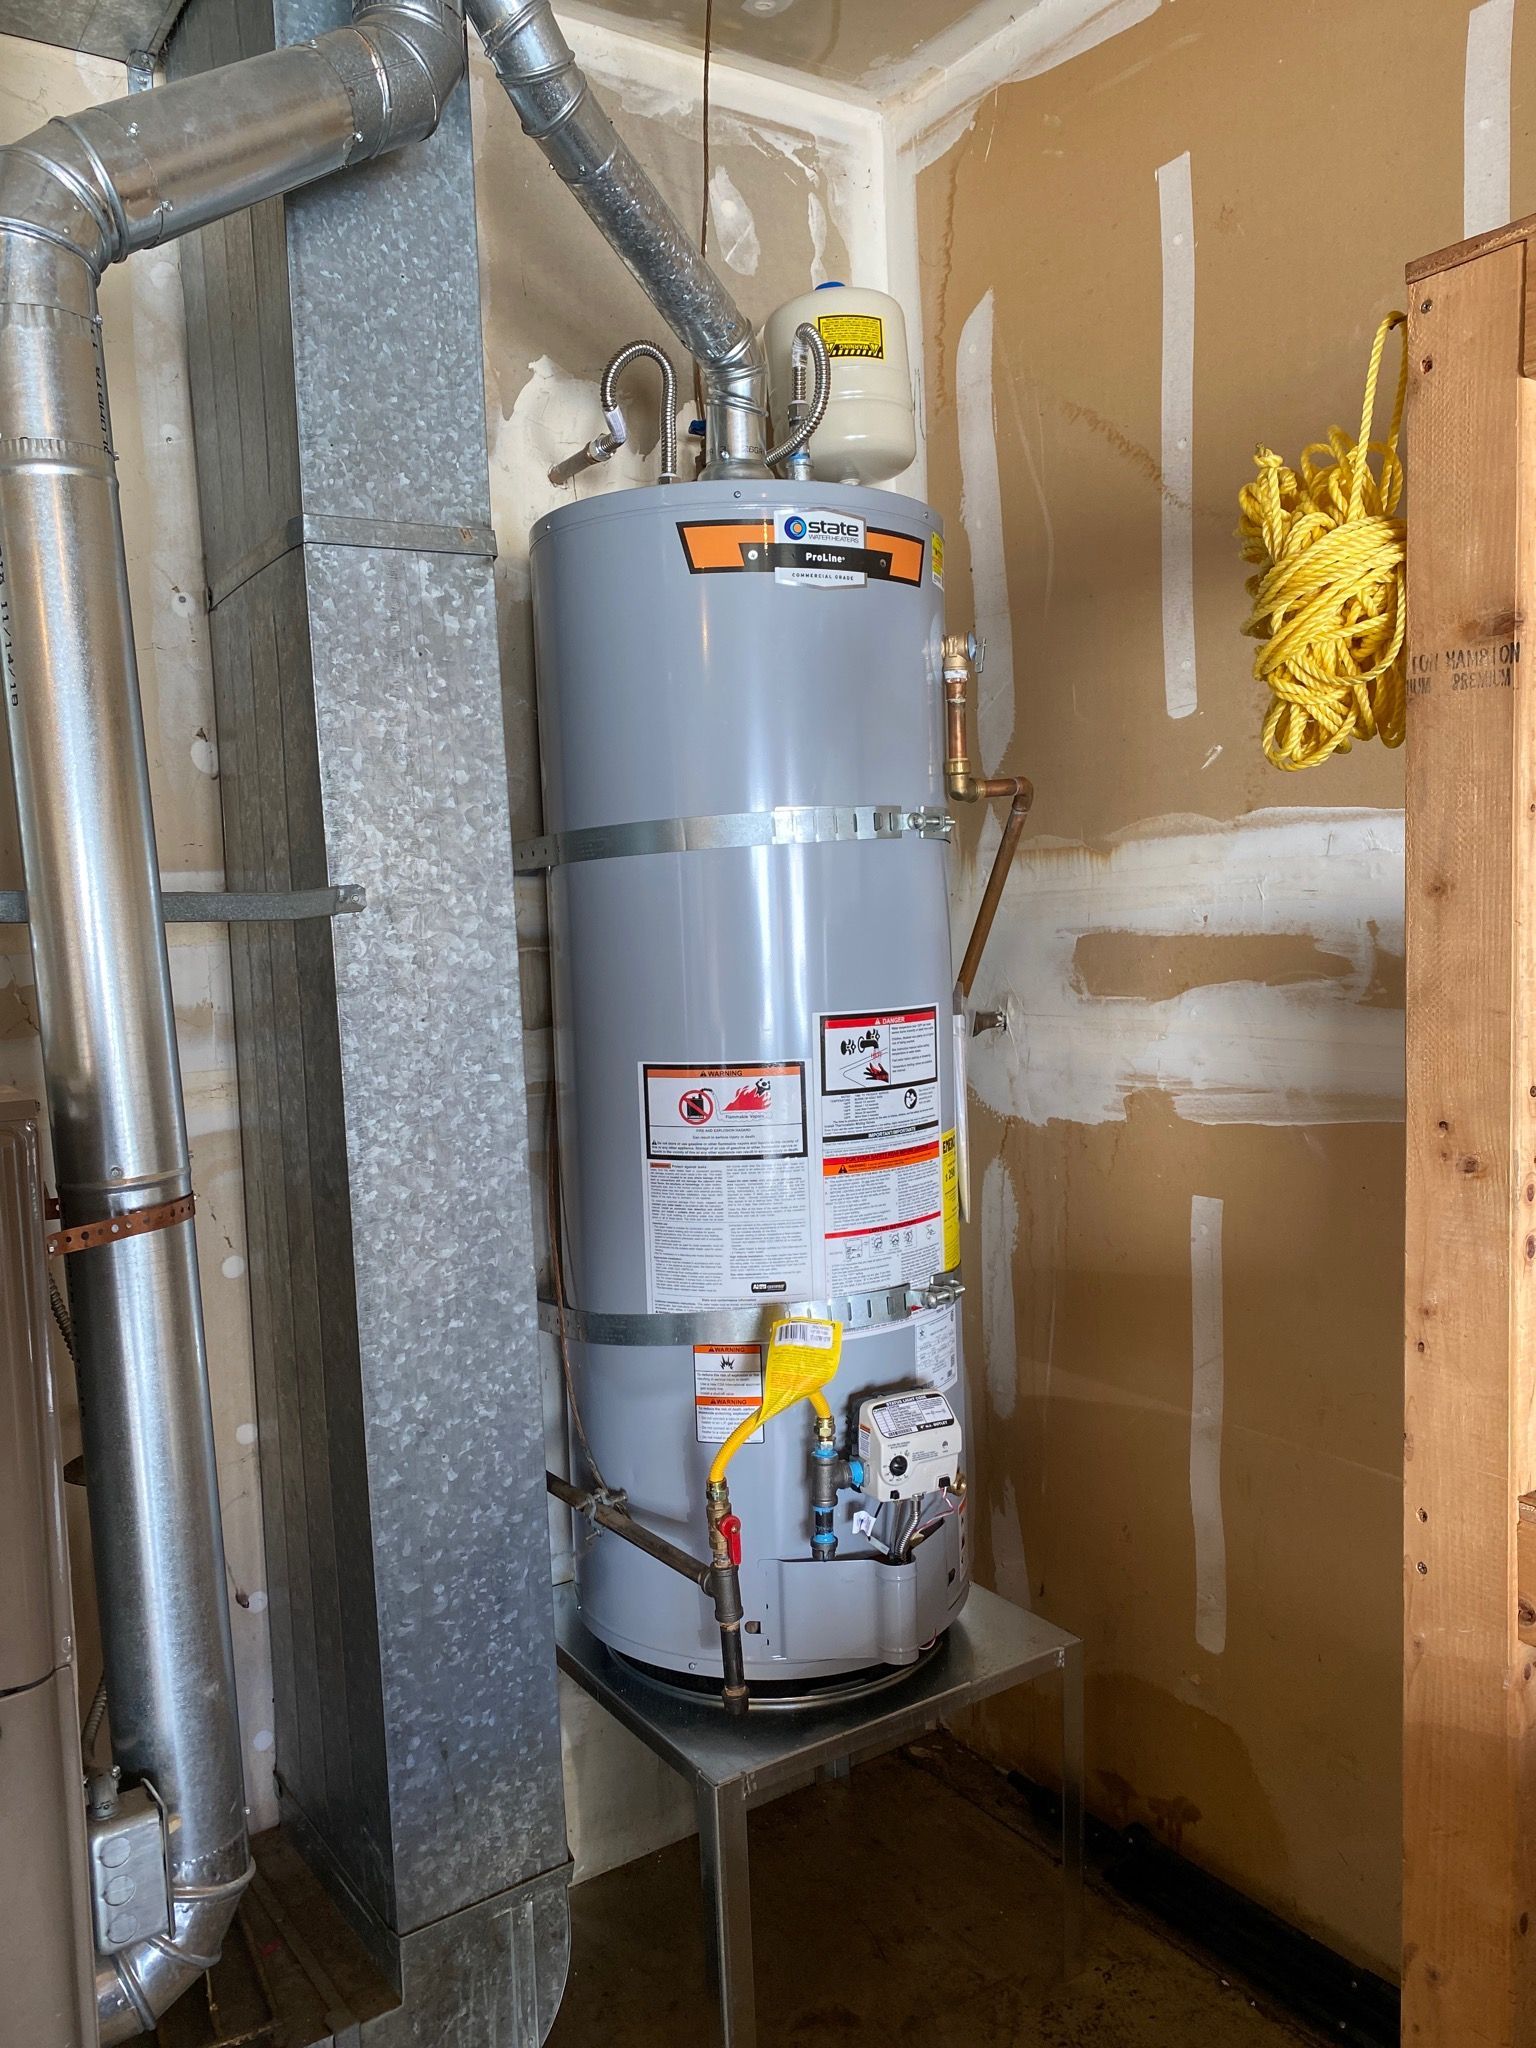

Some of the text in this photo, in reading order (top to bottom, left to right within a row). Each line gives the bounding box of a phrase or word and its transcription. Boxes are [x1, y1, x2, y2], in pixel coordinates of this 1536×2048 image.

[808, 520, 859, 537] state
[831, 536, 859, 544] HEATERS
[882, 1016, 905, 1025] DANGER
[717, 1397, 747, 1405] WARNING
